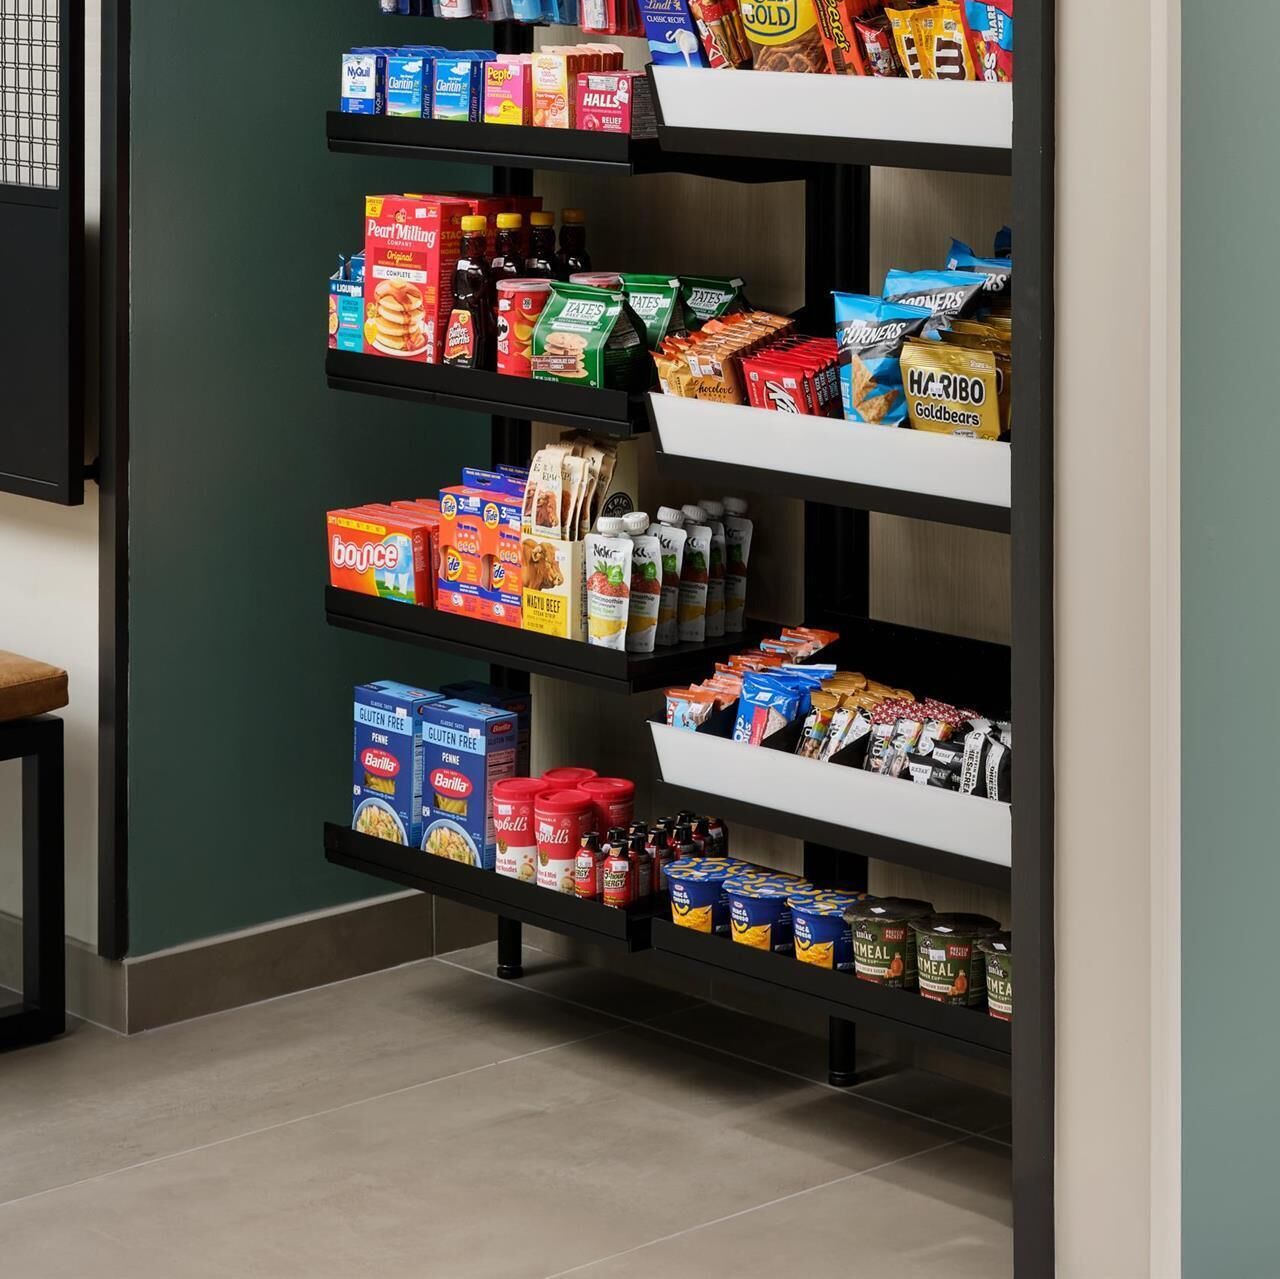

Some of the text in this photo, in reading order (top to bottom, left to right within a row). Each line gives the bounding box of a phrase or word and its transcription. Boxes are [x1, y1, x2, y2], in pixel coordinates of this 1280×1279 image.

[745, 4, 791, 27] GOLD
[347, 66, 371, 79] NyQuil
[487, 66, 513, 81] Pepto
[388, 76, 413, 90] Claritin
[436, 79, 461, 92] Claritin
[583, 93, 621, 108] HALLS
[601, 116, 623, 124] RELIEF
[368, 219, 436, 248] Pearl Milling
[387, 239, 412, 247] COMPANY
[387, 250, 413, 264] Original
[386, 270, 411, 278] COMPLETE
[631, 295, 661, 308] TATE'S
[692, 290, 723, 304] TATE'S
[566, 301, 604, 316] TATE'S
[841, 322, 906, 345] CORNERS
[908, 369, 985, 404] HARIBO
[915, 402, 980, 426] Goldbears
[443, 497, 465, 513] Tide 3
[609, 499, 627, 510] EPIC
[486, 507, 507, 522] Tide 3
[333, 535, 399, 573] bounce
[526, 593, 561, 614] WAGYU BEEF
[359, 707, 404, 731] GLUTEN FREE
[372, 733, 388, 745] PENNE
[428, 727, 477, 751] GLUTEN FREE
[364, 752, 394, 772] Barilla
[442, 752, 460, 766] PENNE
[434, 772, 466, 793] Barilla
